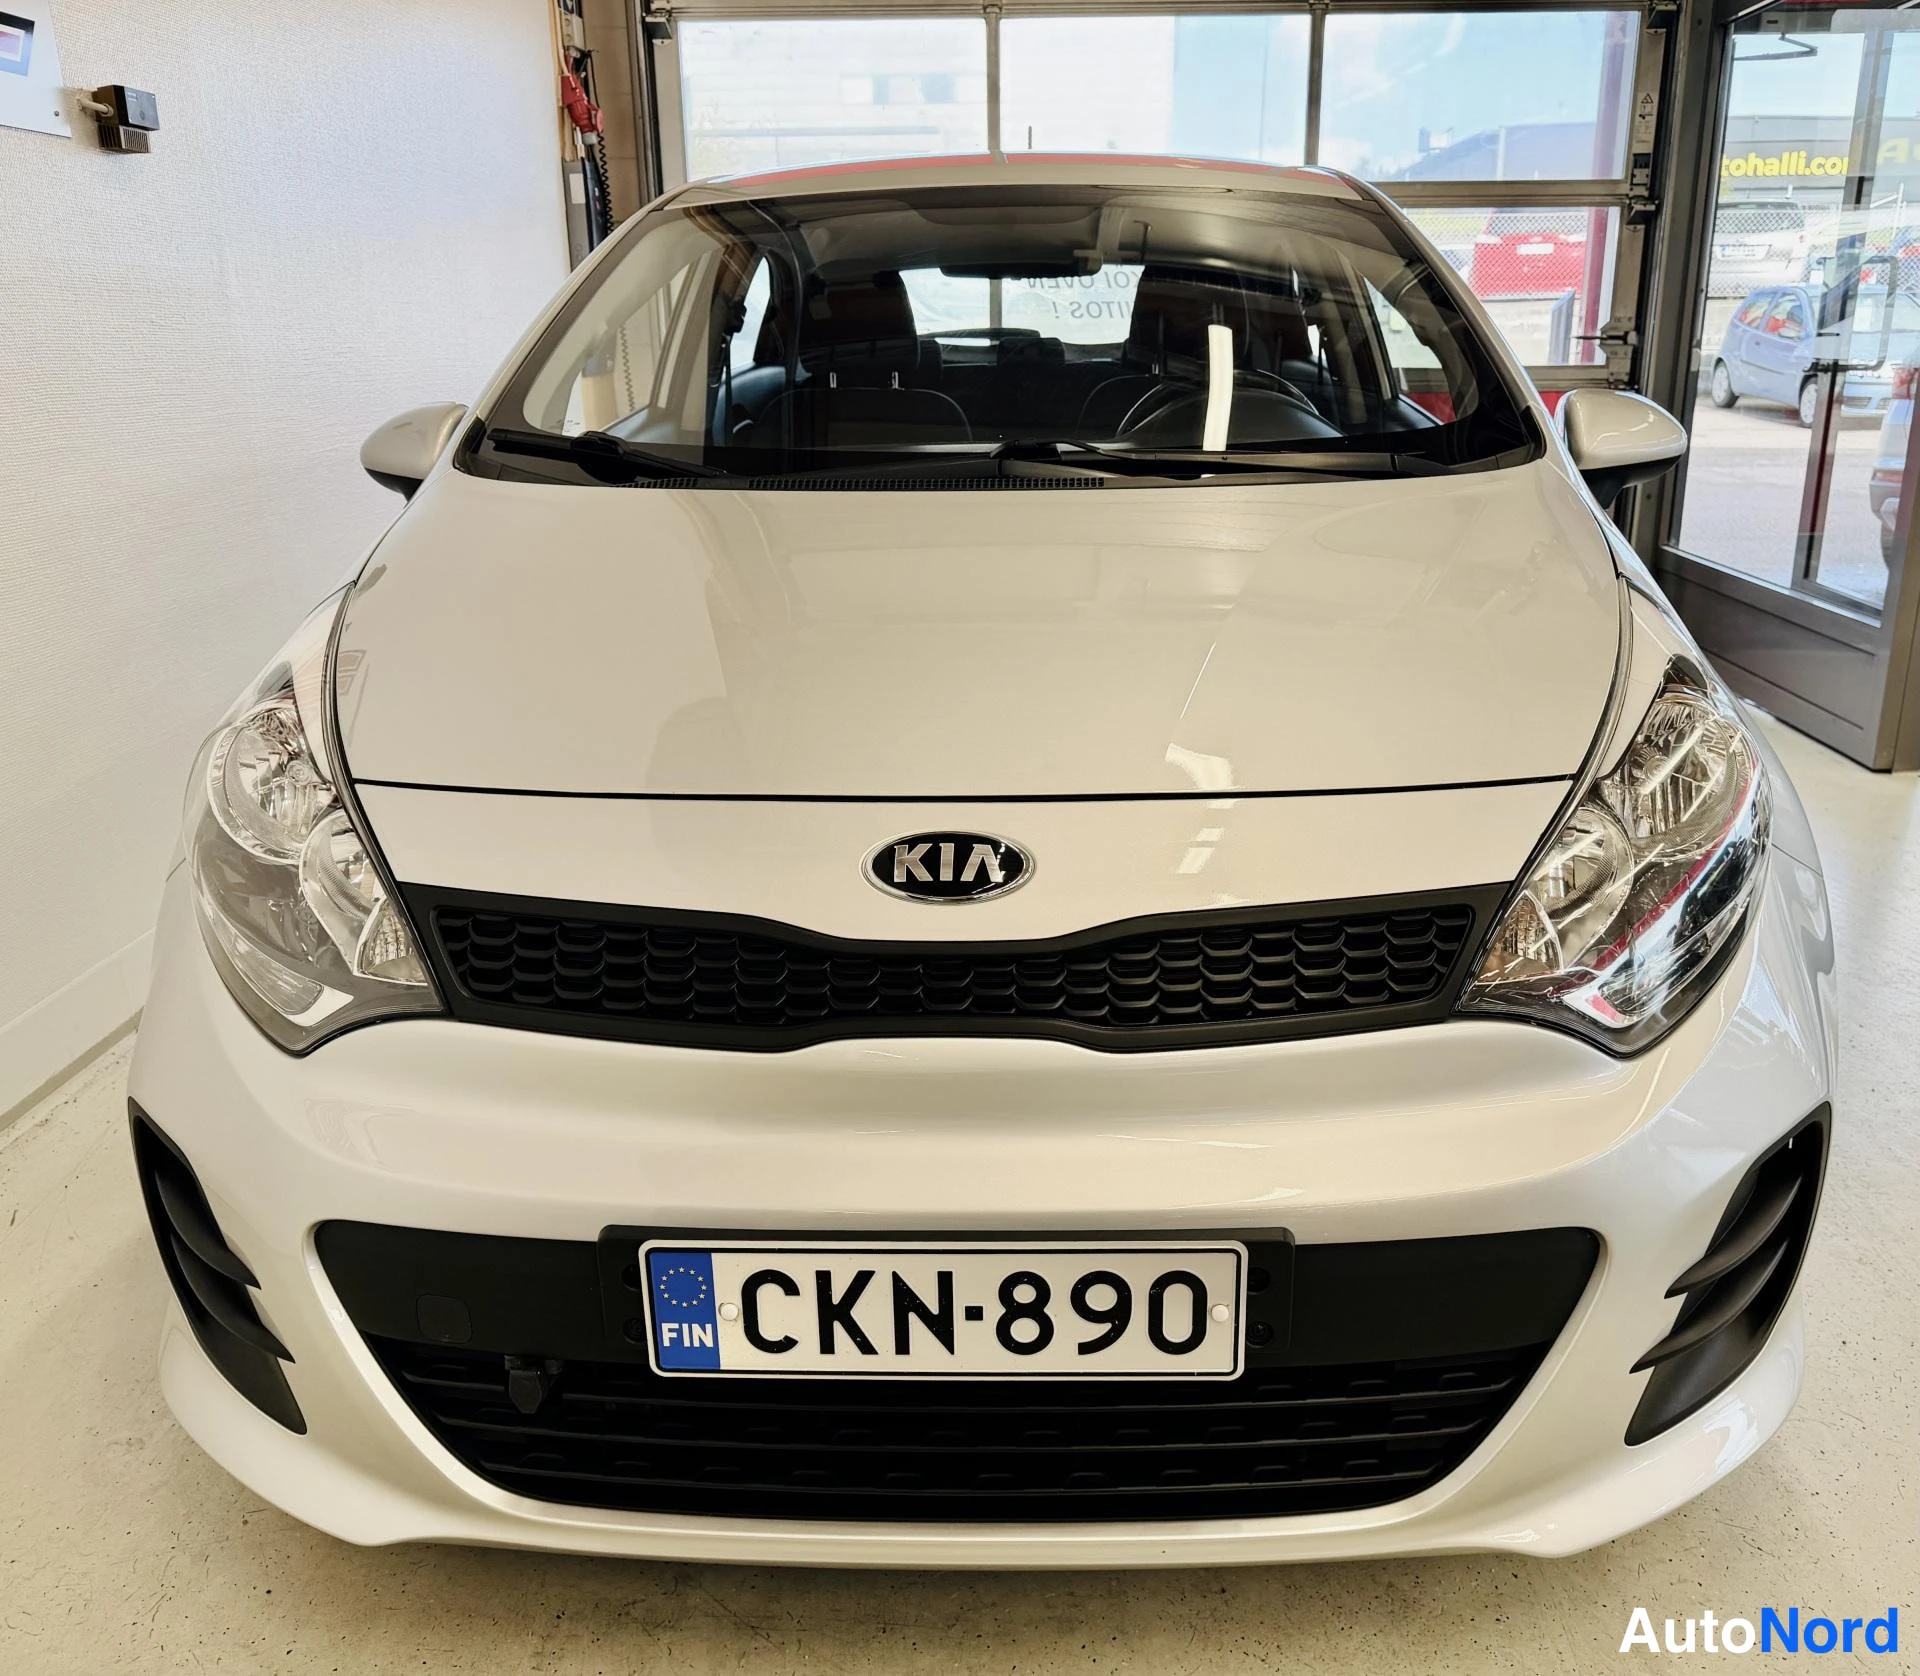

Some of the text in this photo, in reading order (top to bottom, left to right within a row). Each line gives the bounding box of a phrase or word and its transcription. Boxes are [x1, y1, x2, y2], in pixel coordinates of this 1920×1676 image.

[894, 843, 1004, 882] KIA
[741, 1269, 1207, 1355] CKN-890
[661, 1322, 714, 1348] FIN
